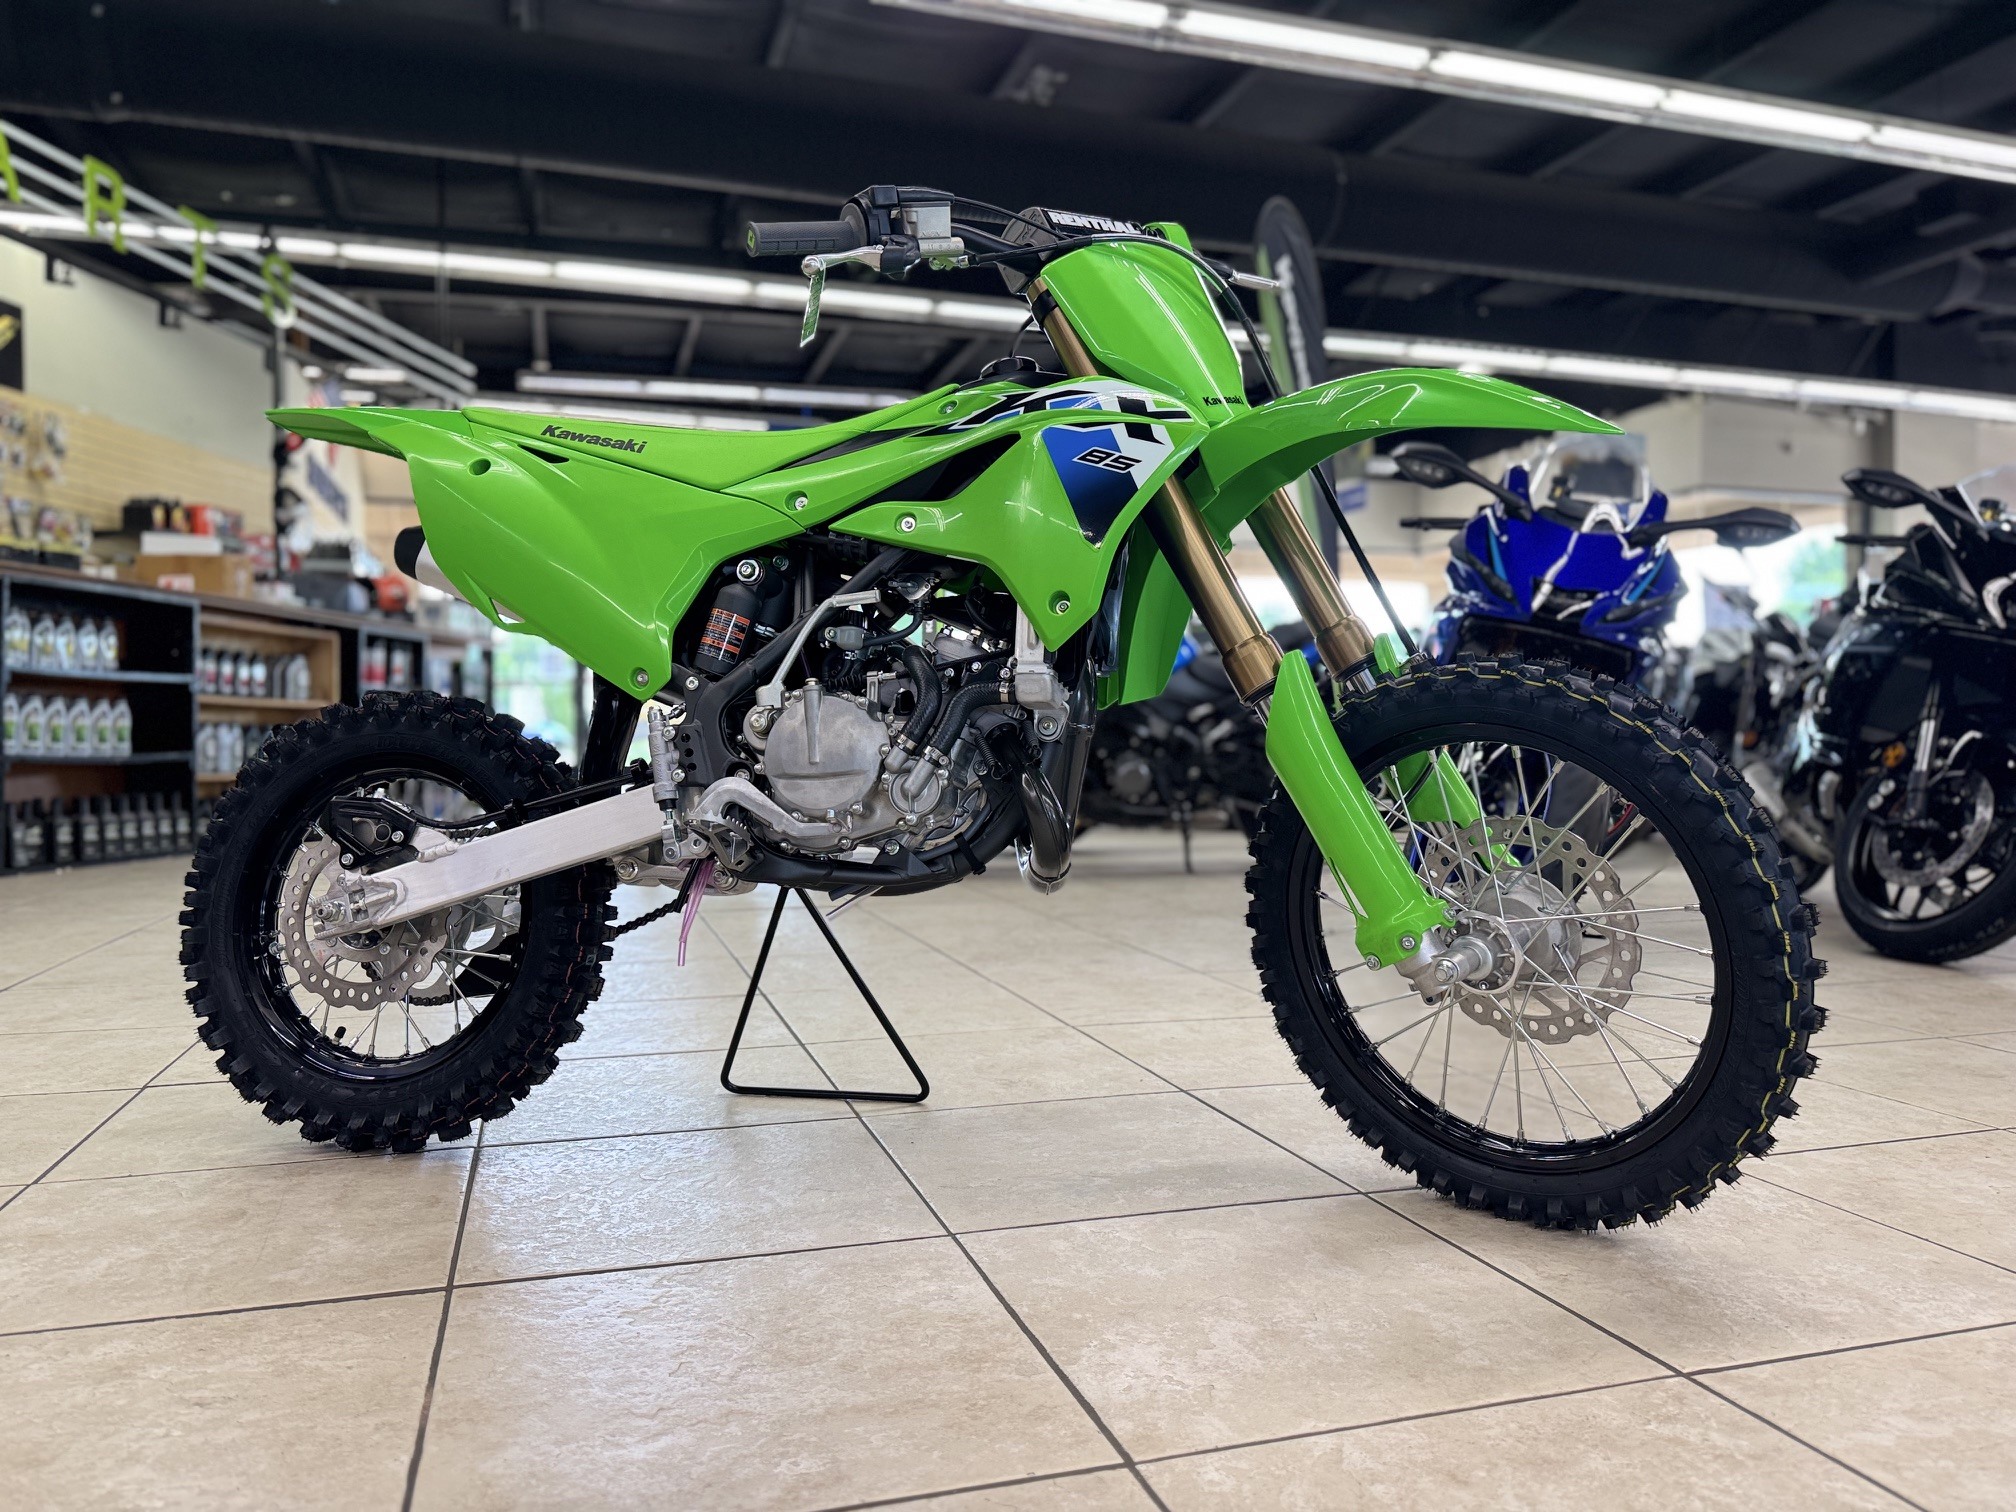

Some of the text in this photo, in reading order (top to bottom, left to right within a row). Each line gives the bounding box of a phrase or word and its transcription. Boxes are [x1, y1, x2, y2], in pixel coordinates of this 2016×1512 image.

[1047, 210, 1142, 234] RENTHAL
[540, 424, 648, 454] Kawasaki
[1075, 447, 1143, 473] 85
